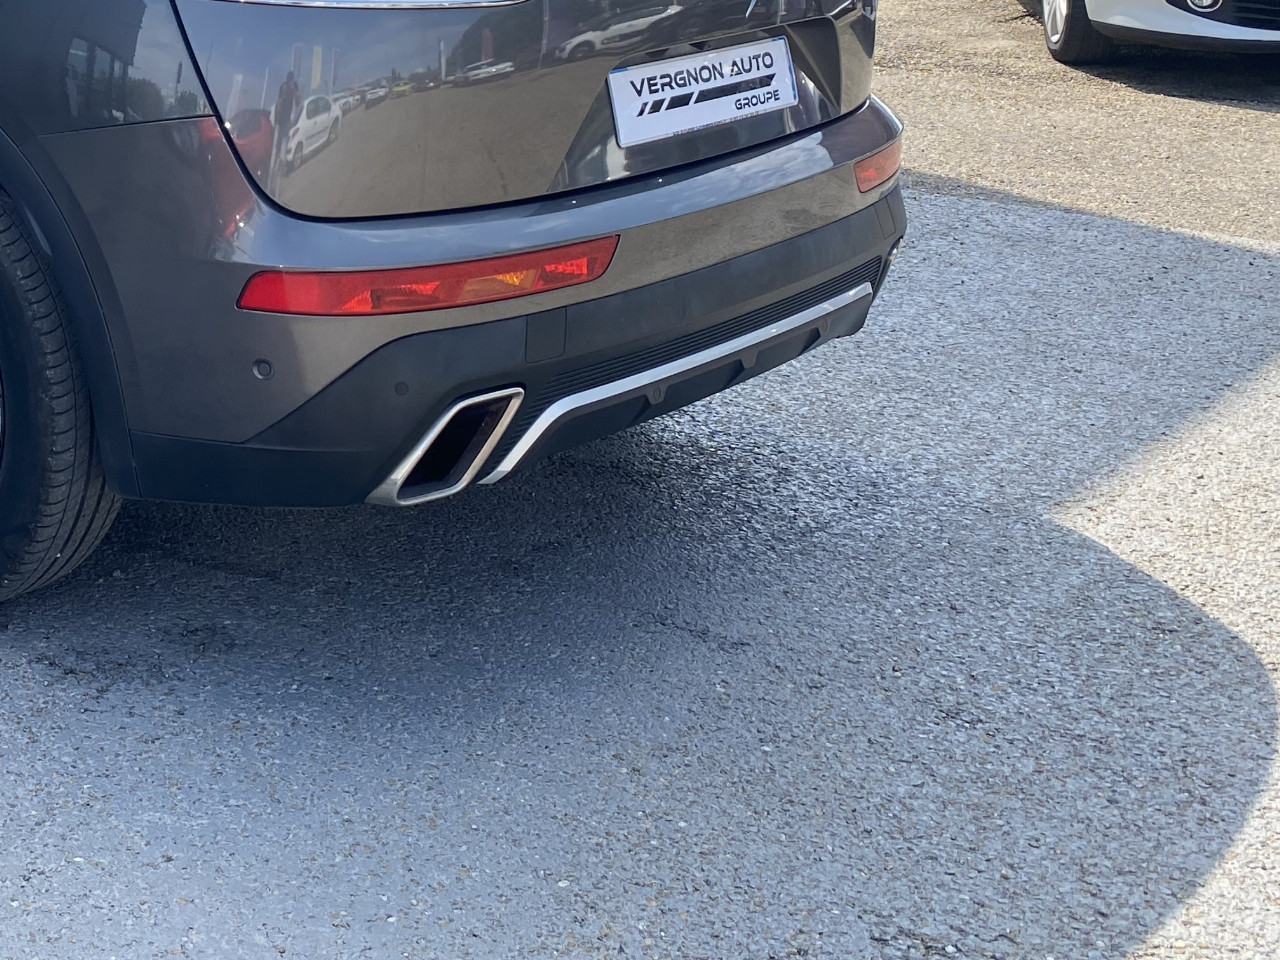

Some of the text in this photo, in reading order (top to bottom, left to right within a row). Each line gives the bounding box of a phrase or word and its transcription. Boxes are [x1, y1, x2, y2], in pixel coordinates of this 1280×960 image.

[630, 51, 774, 97] VERGNON AUTO
[735, 89, 781, 111] GROUPE
